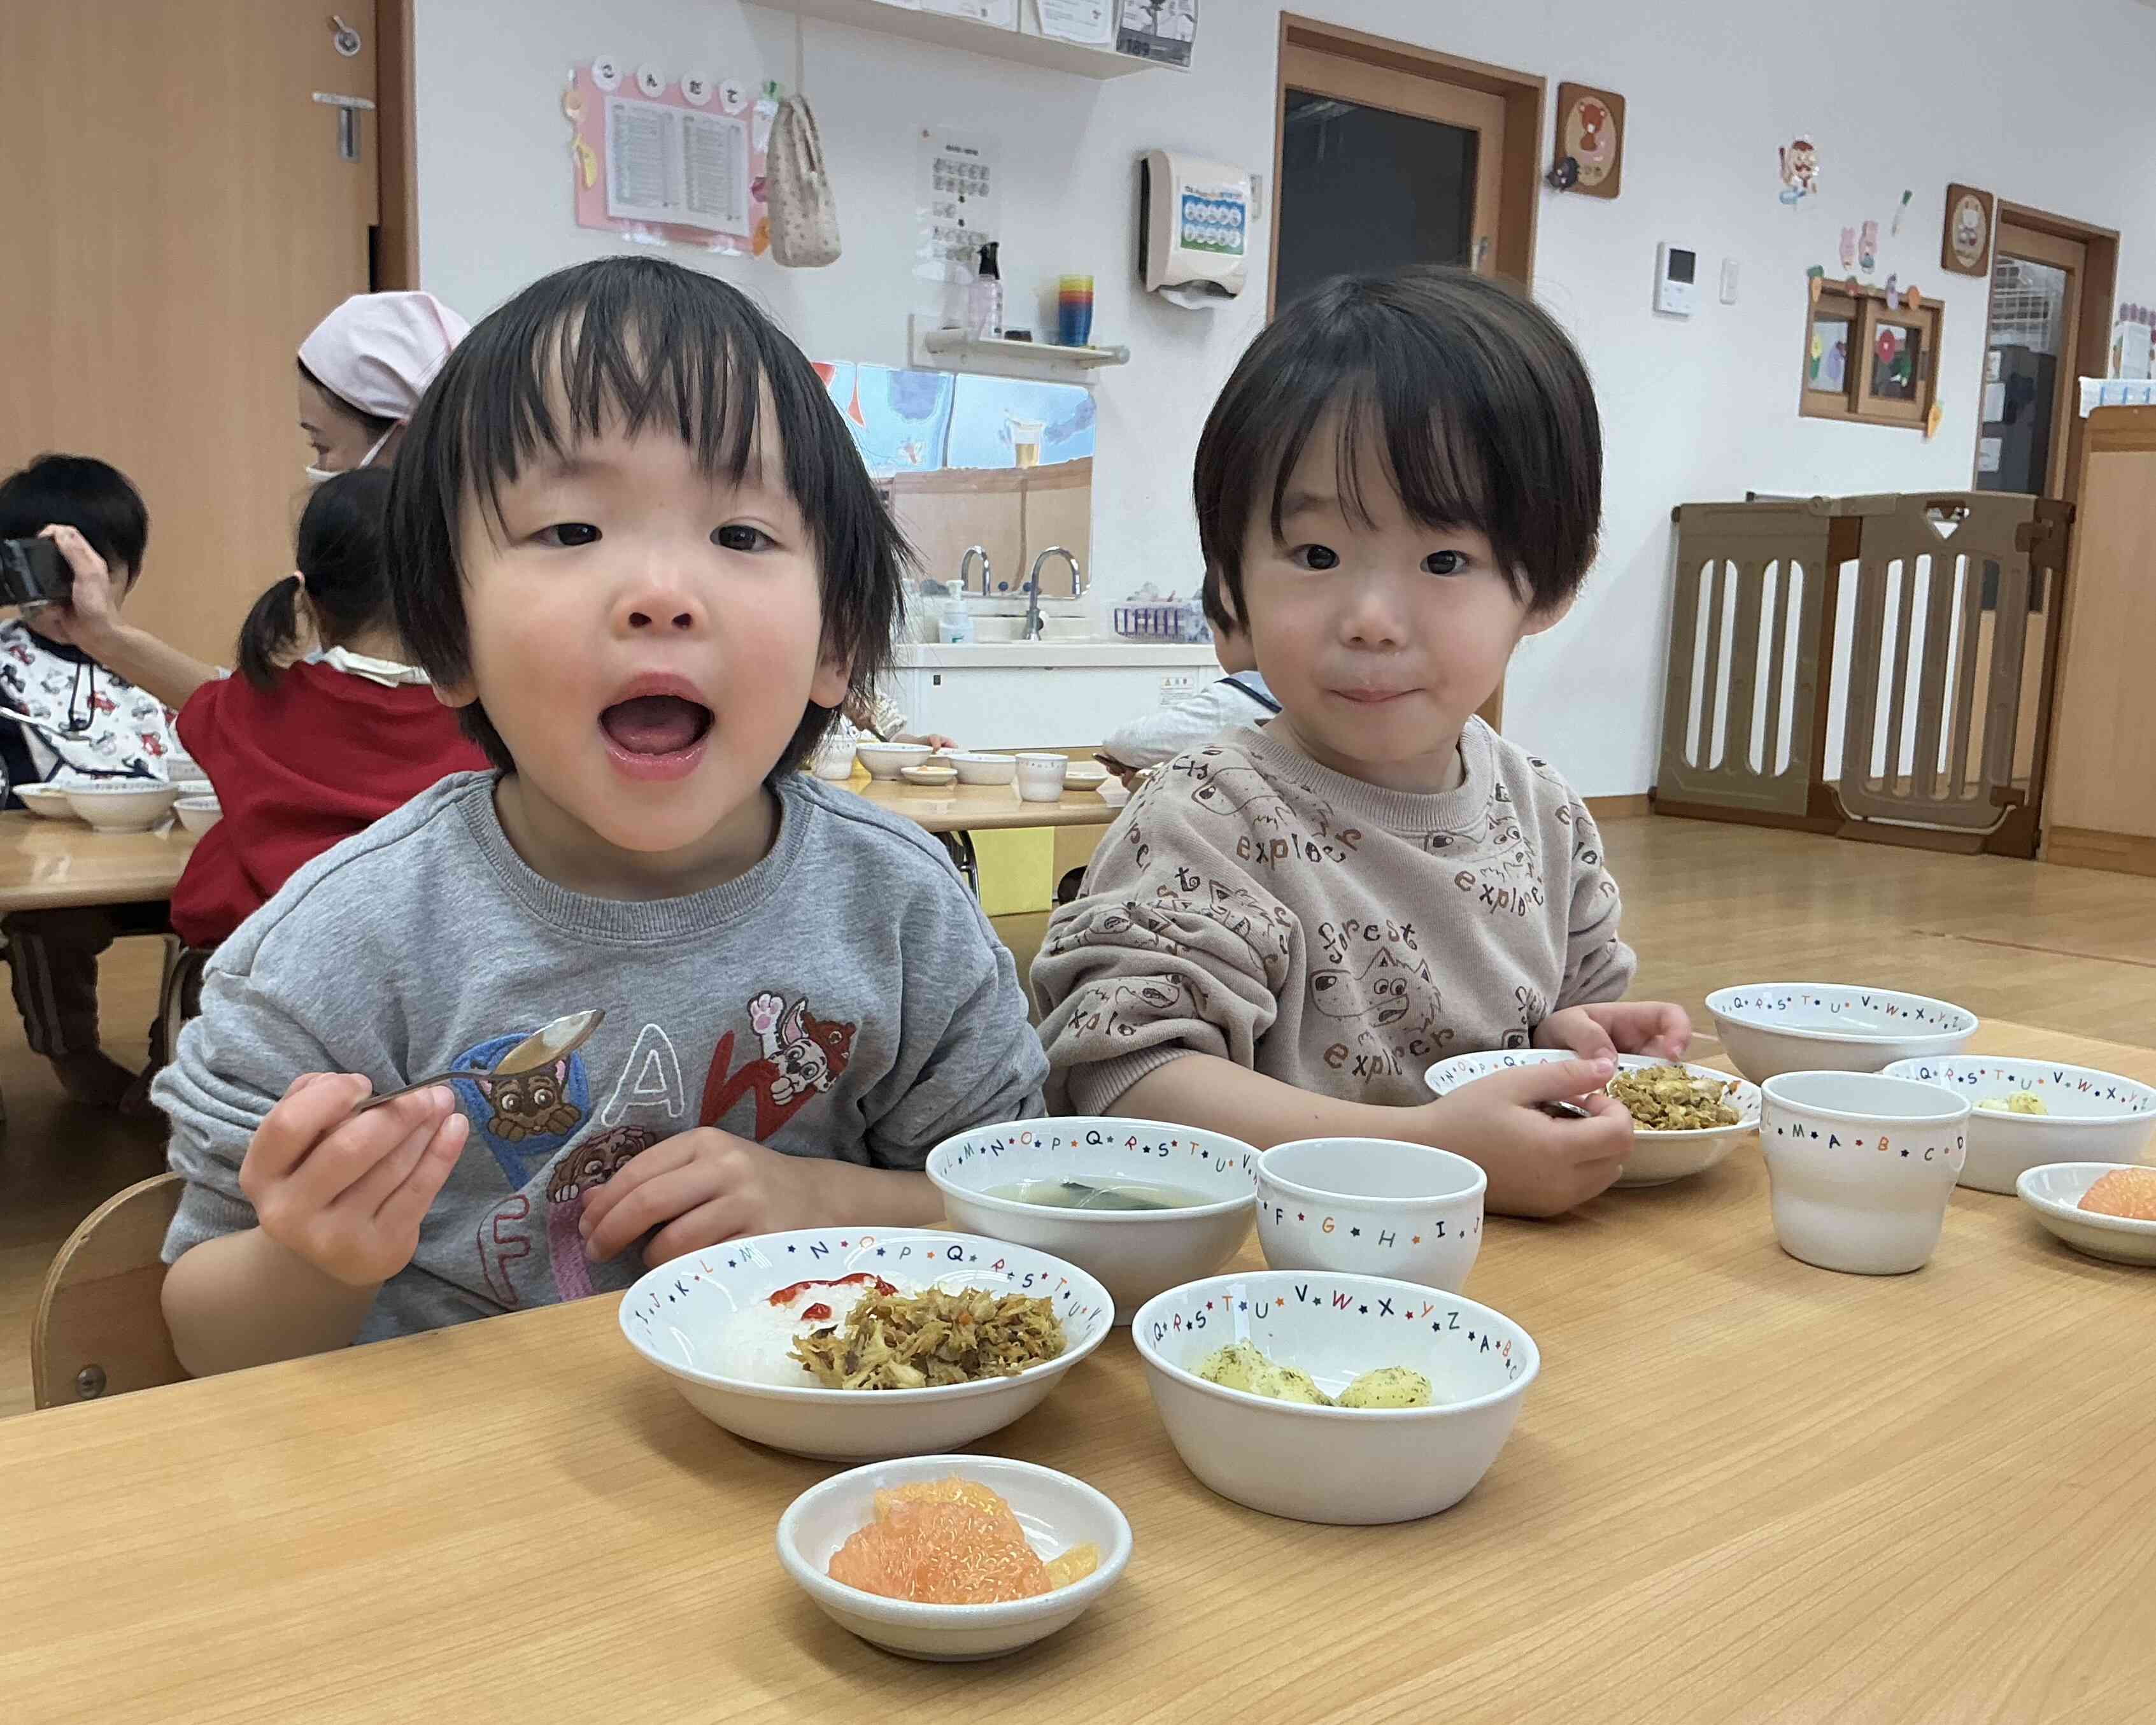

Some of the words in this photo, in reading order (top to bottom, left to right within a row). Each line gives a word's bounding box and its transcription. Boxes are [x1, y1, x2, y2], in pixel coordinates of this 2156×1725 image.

[1236, 828, 1362, 871] exploer
[1318, 919, 1418, 964] forest
[1734, 997, 1743, 1008] Q
[1778, 1000, 1786, 1010] S
[1801, 995, 1810, 1005] T
[1831, 1004, 1840, 1013] U
[1862, 996, 1870, 1007] V
[1885, 1003, 1899, 1015] W
[1915, 1008, 1924, 1019] X
[1920, 1067, 1931, 1079] Q
[1968, 1072, 1976, 1084] S
[1994, 1070, 2004, 1080] T
[2021, 1079, 2032, 1090] U
[2054, 1072, 2063, 1083] V
[2078, 1079, 2092, 1091] W
[2107, 1088, 2116, 1099] X
[991, 1139, 1005, 1156] N
[1021, 1132, 1032, 1145] O
[1052, 1137, 1060, 1150] P
[1086, 1131, 1103, 1145] Q
[1124, 1136, 1137, 1151] R
[1159, 1143, 1169, 1156] S
[1190, 1142, 1199, 1155] T
[1216, 1158, 1225, 1172] U
[1243, 1154, 1251, 1168] V
[1792, 1124, 1805, 1137] M
[1829, 1134, 1840, 1149] A
[1878, 1137, 1889, 1151] B
[1924, 1147, 1934, 1161] C
[1276, 1209, 1283, 1225] F
[1322, 1217, 1335, 1233] G
[1378, 1230, 1396, 1247] H
[1436, 1221, 1445, 1238] I
[675, 1280, 689, 1296] K
[700, 1260, 713, 1274] L
[810, 1241, 829, 1260] N
[899, 1247, 911, 1260] P
[947, 1246, 963, 1261] Q
[991, 1259, 1005, 1272] R
[1023, 1274, 1034, 1288] S
[1054, 1277, 1068, 1291] T
[1068, 1302, 1080, 1317] U
[1154, 1323, 1164, 1341] Q
[1174, 1314, 1181, 1331] R
[1196, 1310, 1206, 1328] S
[1223, 1295, 1233, 1311] T
[1256, 1303, 1268, 1318] U
[1295, 1284, 1308, 1302] V
[1333, 1290, 1352, 1309] W
[1378, 1298, 1394, 1317] X
[1421, 1302, 1434, 1317] Y
[1448, 1312, 1459, 1330] Z
[1480, 1335, 1490, 1352] A
[1503, 1340, 1512, 1356] B
